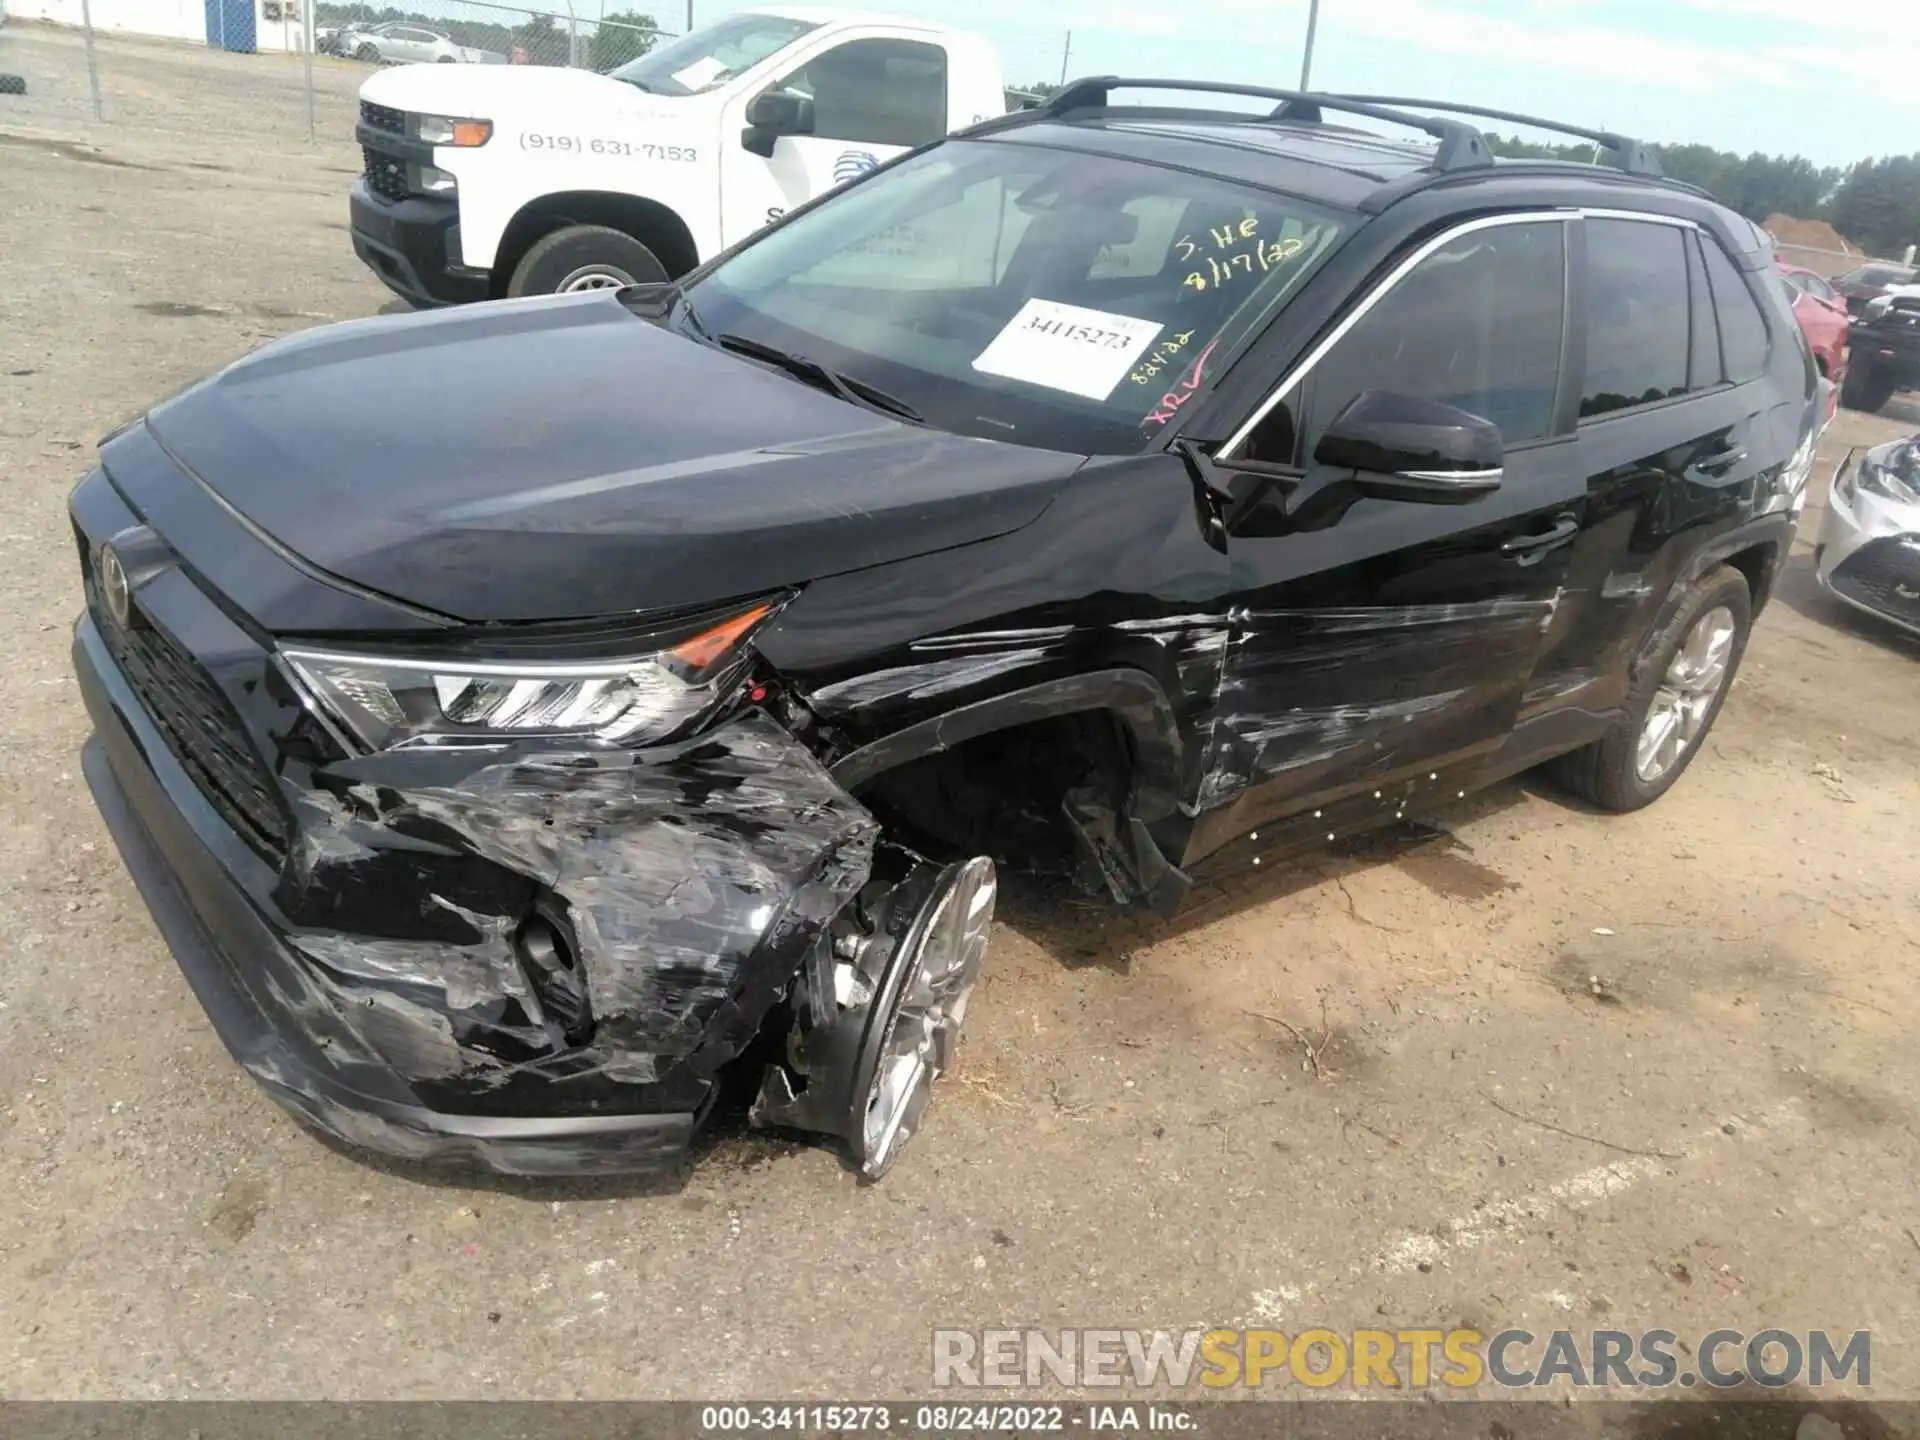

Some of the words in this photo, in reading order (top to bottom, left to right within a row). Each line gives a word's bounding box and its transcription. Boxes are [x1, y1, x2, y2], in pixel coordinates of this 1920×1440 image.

[519, 132, 582, 154] (919)
[590, 138, 698, 163] 631-7153
[1021, 315, 1132, 349] 34115273
